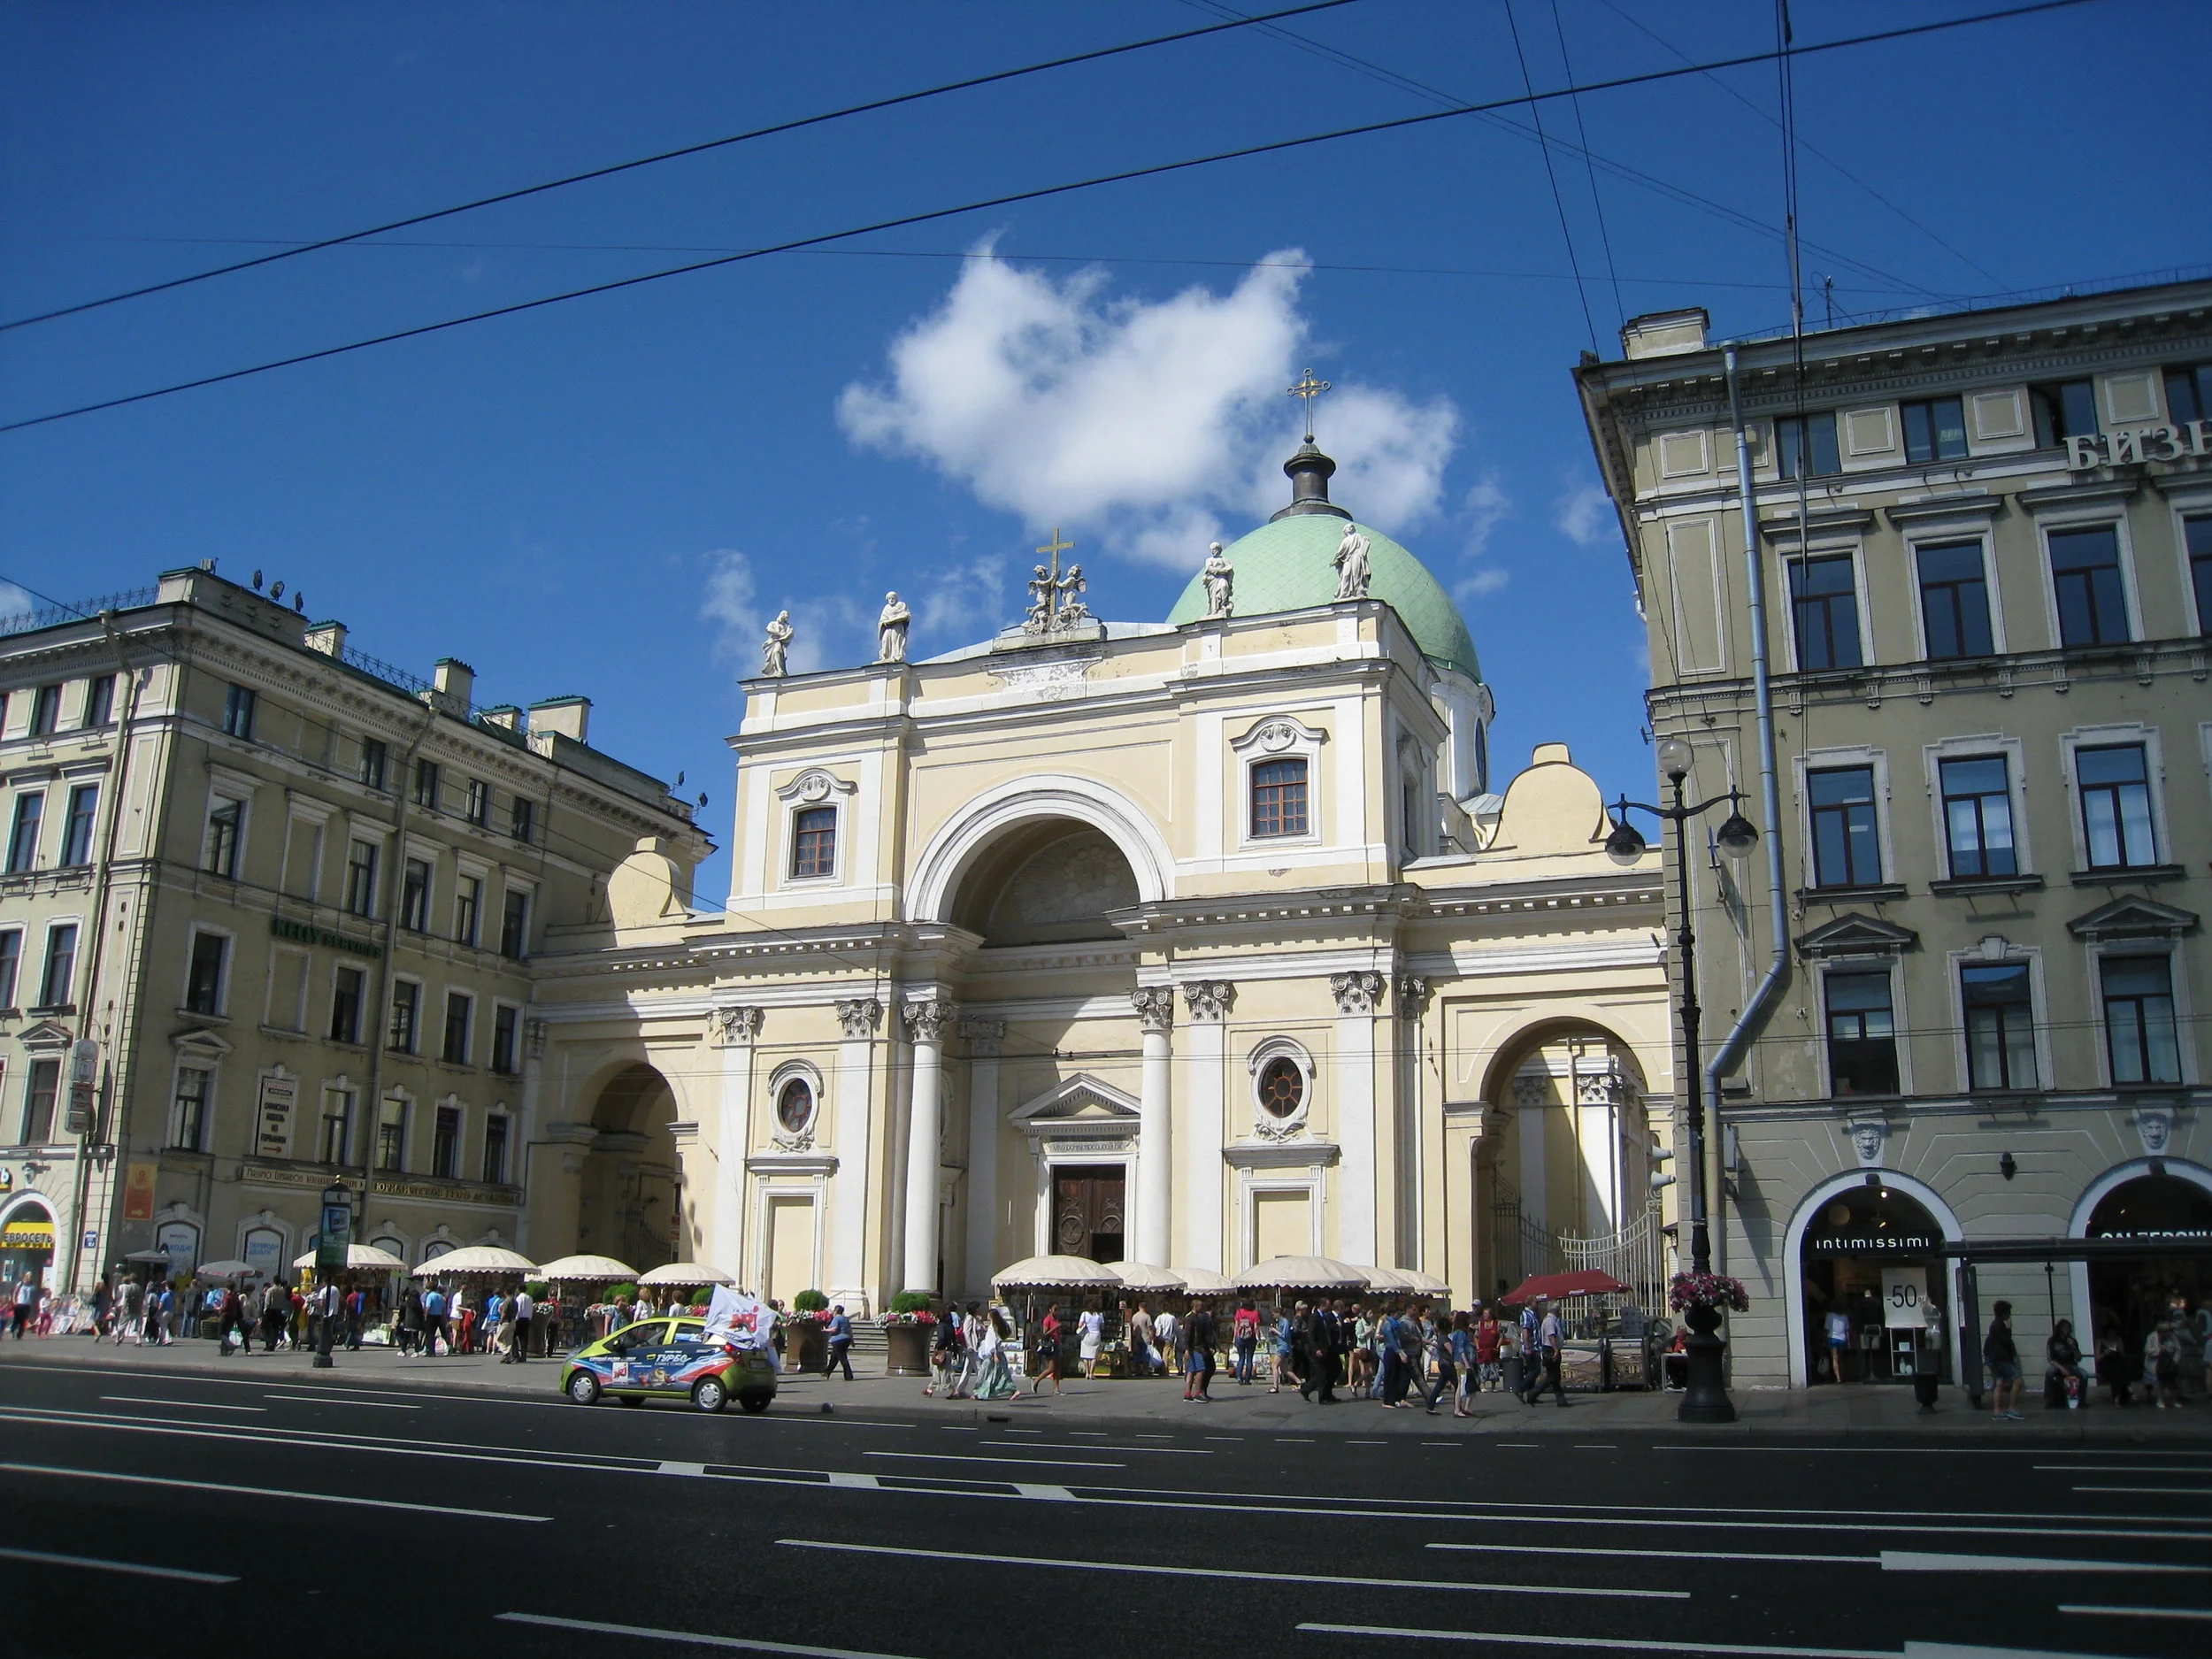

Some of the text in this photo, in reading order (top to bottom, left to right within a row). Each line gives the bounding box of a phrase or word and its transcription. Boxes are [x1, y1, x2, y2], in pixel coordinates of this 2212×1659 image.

[4, 1232, 53, 1243] ЕВРОСЕТЬ
[1815, 1235, 1930, 1250] intimissimi
[655, 1354, 690, 1363] ТУРБО
